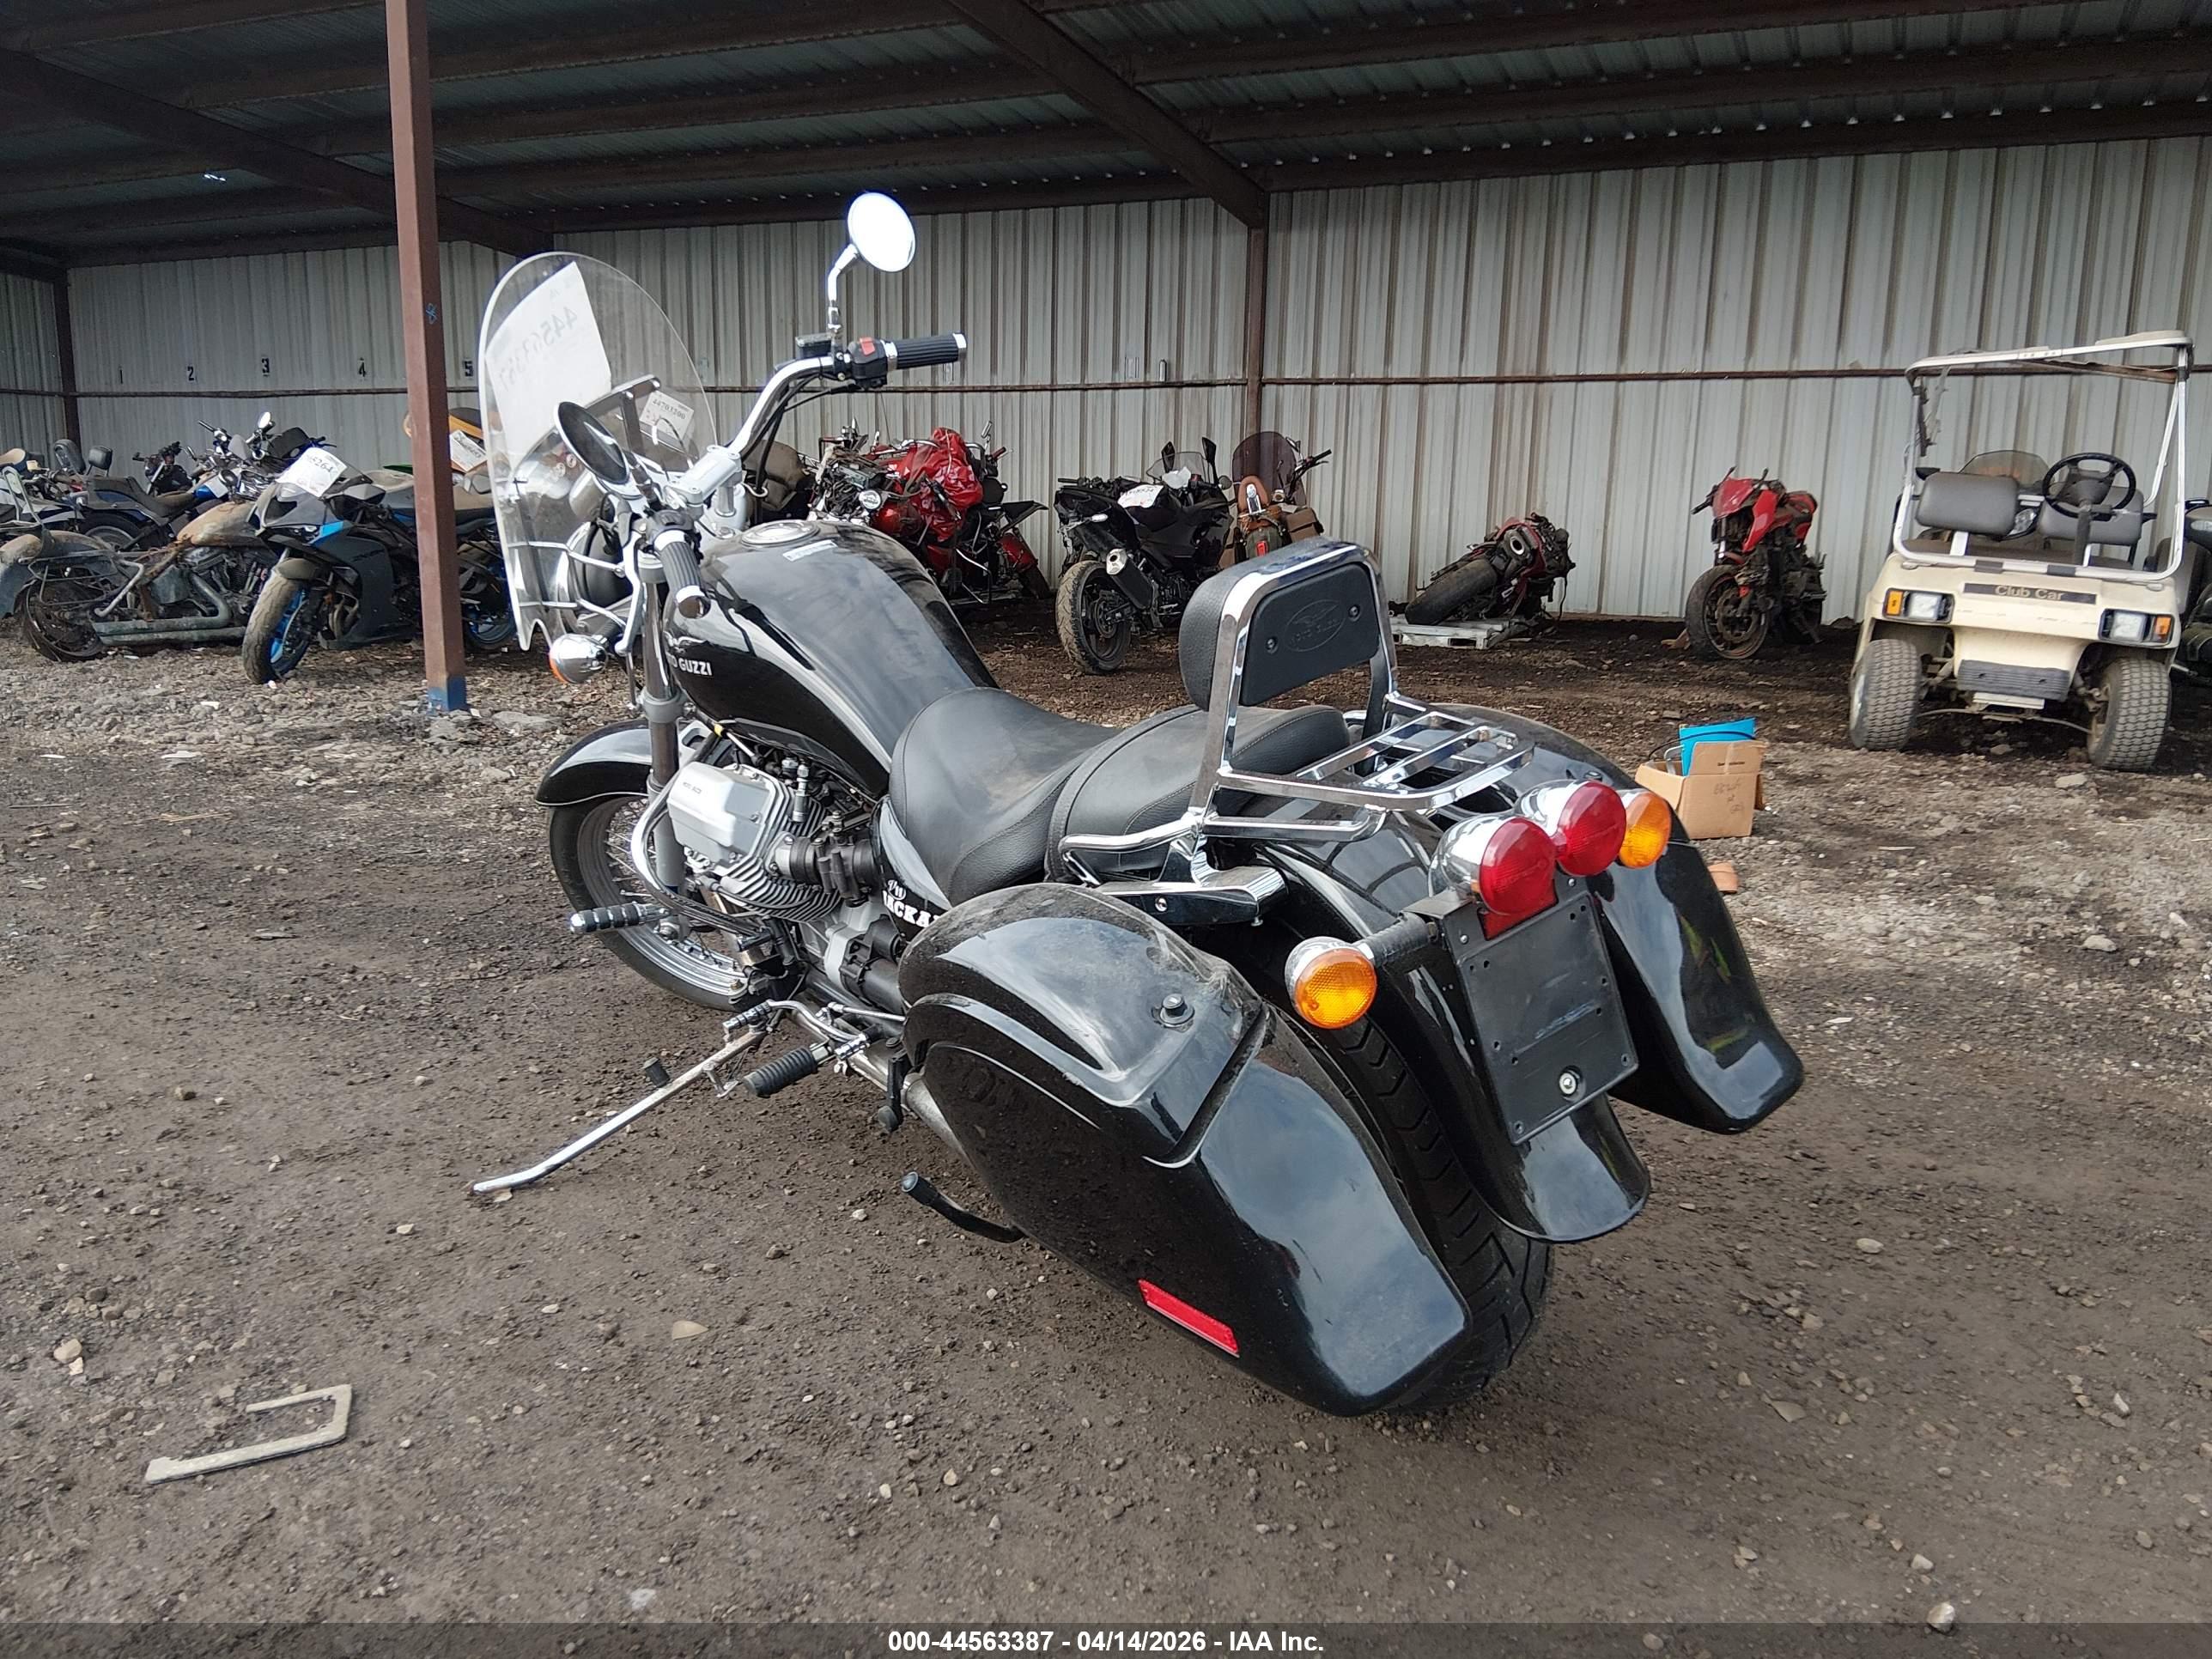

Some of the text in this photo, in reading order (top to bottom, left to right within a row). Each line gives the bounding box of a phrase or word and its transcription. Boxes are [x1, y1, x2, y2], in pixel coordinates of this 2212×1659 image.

[186, 366, 195, 381] 2
[261, 357, 270, 374] 3
[464, 361, 474, 378] 5
[1995, 584, 2065, 601] Club Car
[678, 657, 713, 677] GUZZI
[882, 890, 940, 928] ACKA
